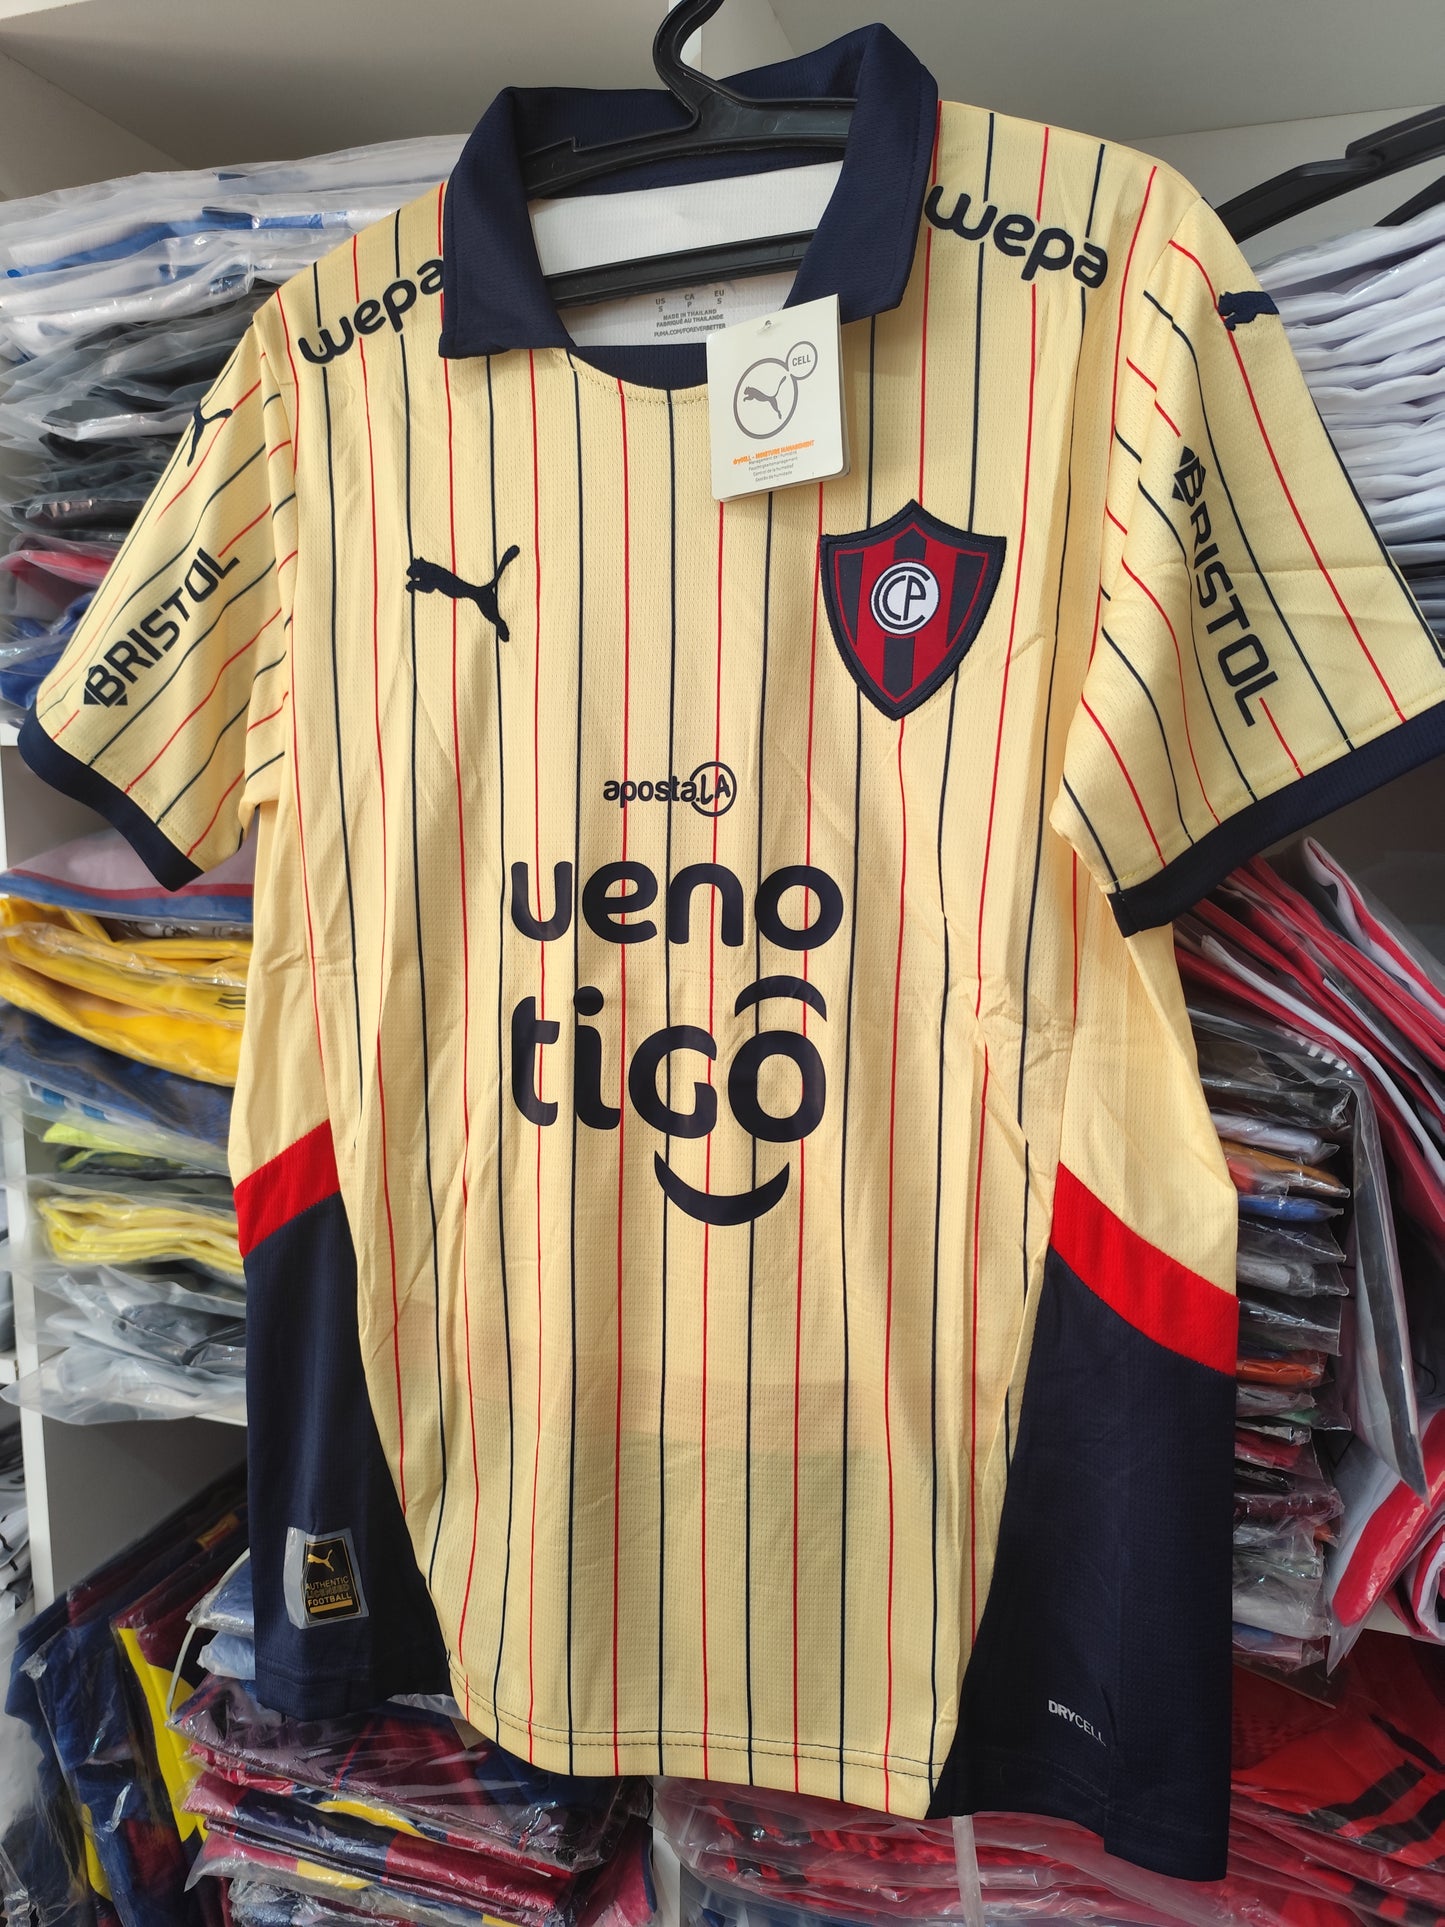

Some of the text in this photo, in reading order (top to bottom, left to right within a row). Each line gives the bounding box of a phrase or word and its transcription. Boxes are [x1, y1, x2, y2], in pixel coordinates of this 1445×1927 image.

[926, 185, 1109, 288] wepa
[298, 258, 444, 366] wepa
[655, 289, 725, 305] US CA EU
[663, 312, 679, 320] MADE
[687, 309, 717, 317] THAILAND
[792, 354, 812, 367] CELL
[1172, 447, 1279, 728] BRISTOL
[84, 547, 241, 708] BRISTOL
[510, 860, 844, 951] ueno
[306, 1576, 350, 1590] AUTHENTIC
[307, 1592, 352, 1607] FOOTBALL
[1048, 1699, 1107, 1748] DRYCELL
